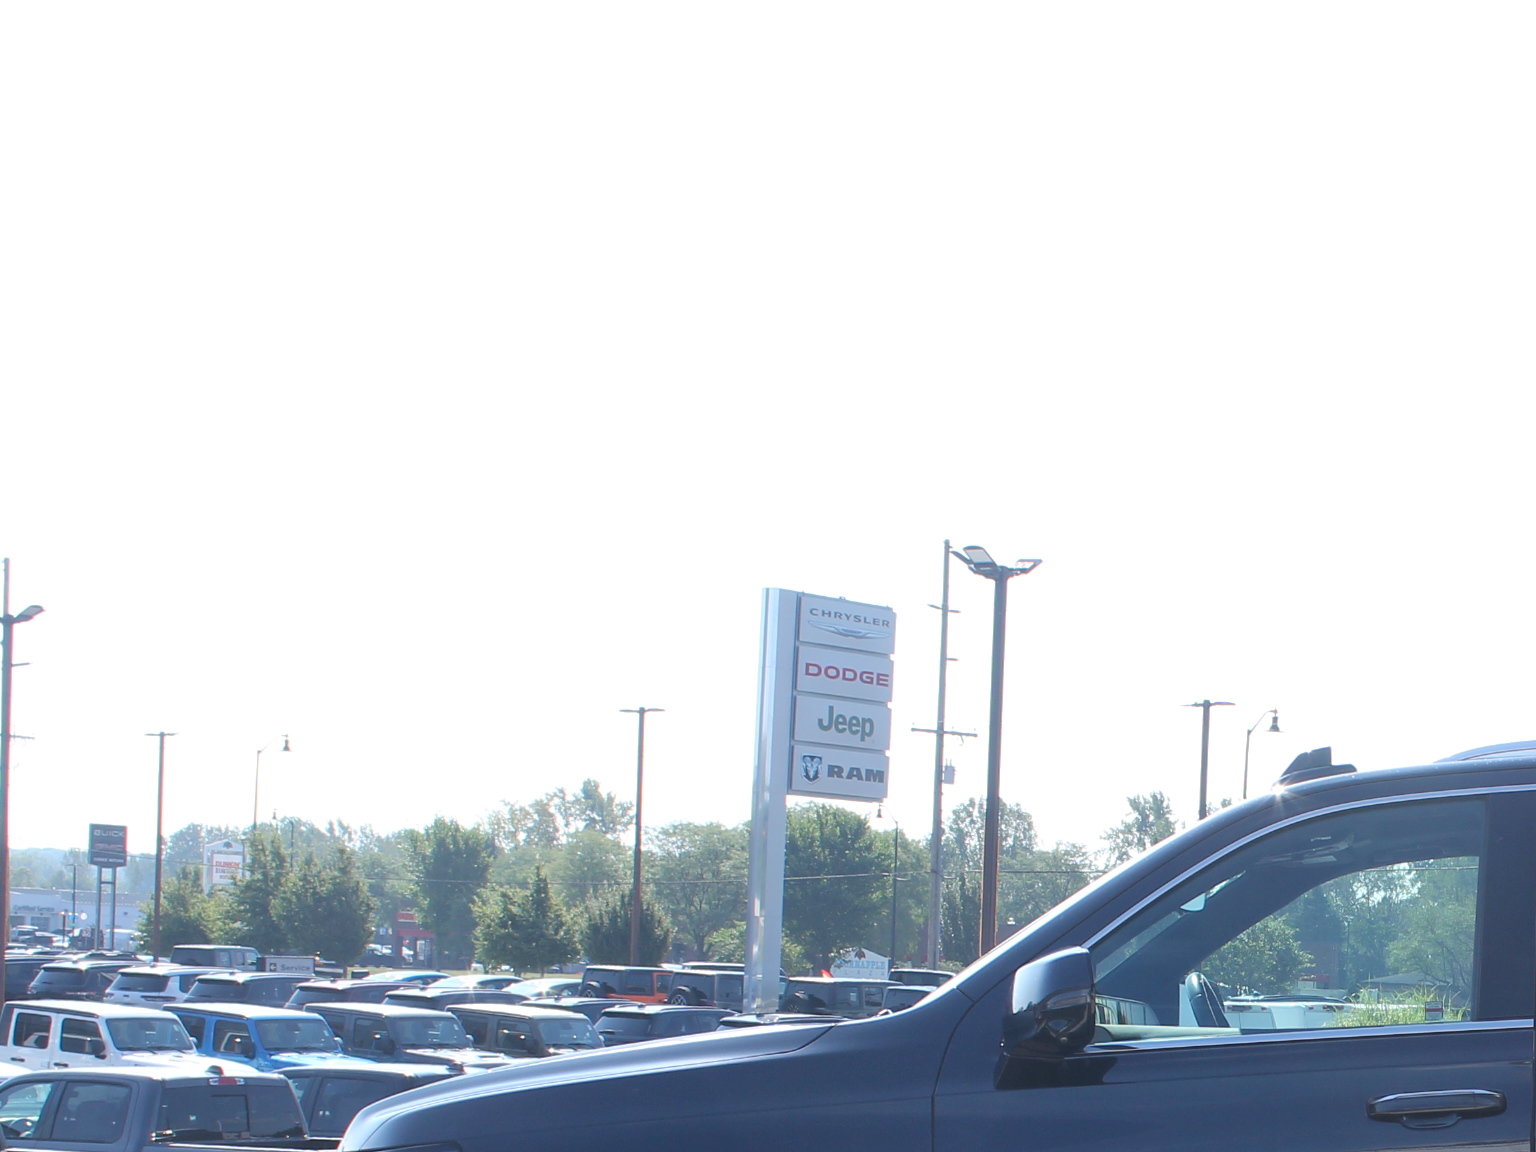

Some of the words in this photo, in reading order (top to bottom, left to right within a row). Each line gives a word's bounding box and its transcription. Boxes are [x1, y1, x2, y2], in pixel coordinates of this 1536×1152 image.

[810, 608, 891, 628] CHRYSLER
[805, 662, 890, 687] DODGE
[817, 705, 875, 742] Jeep
[827, 764, 885, 784] RAM
[93, 829, 124, 837] BUICK
